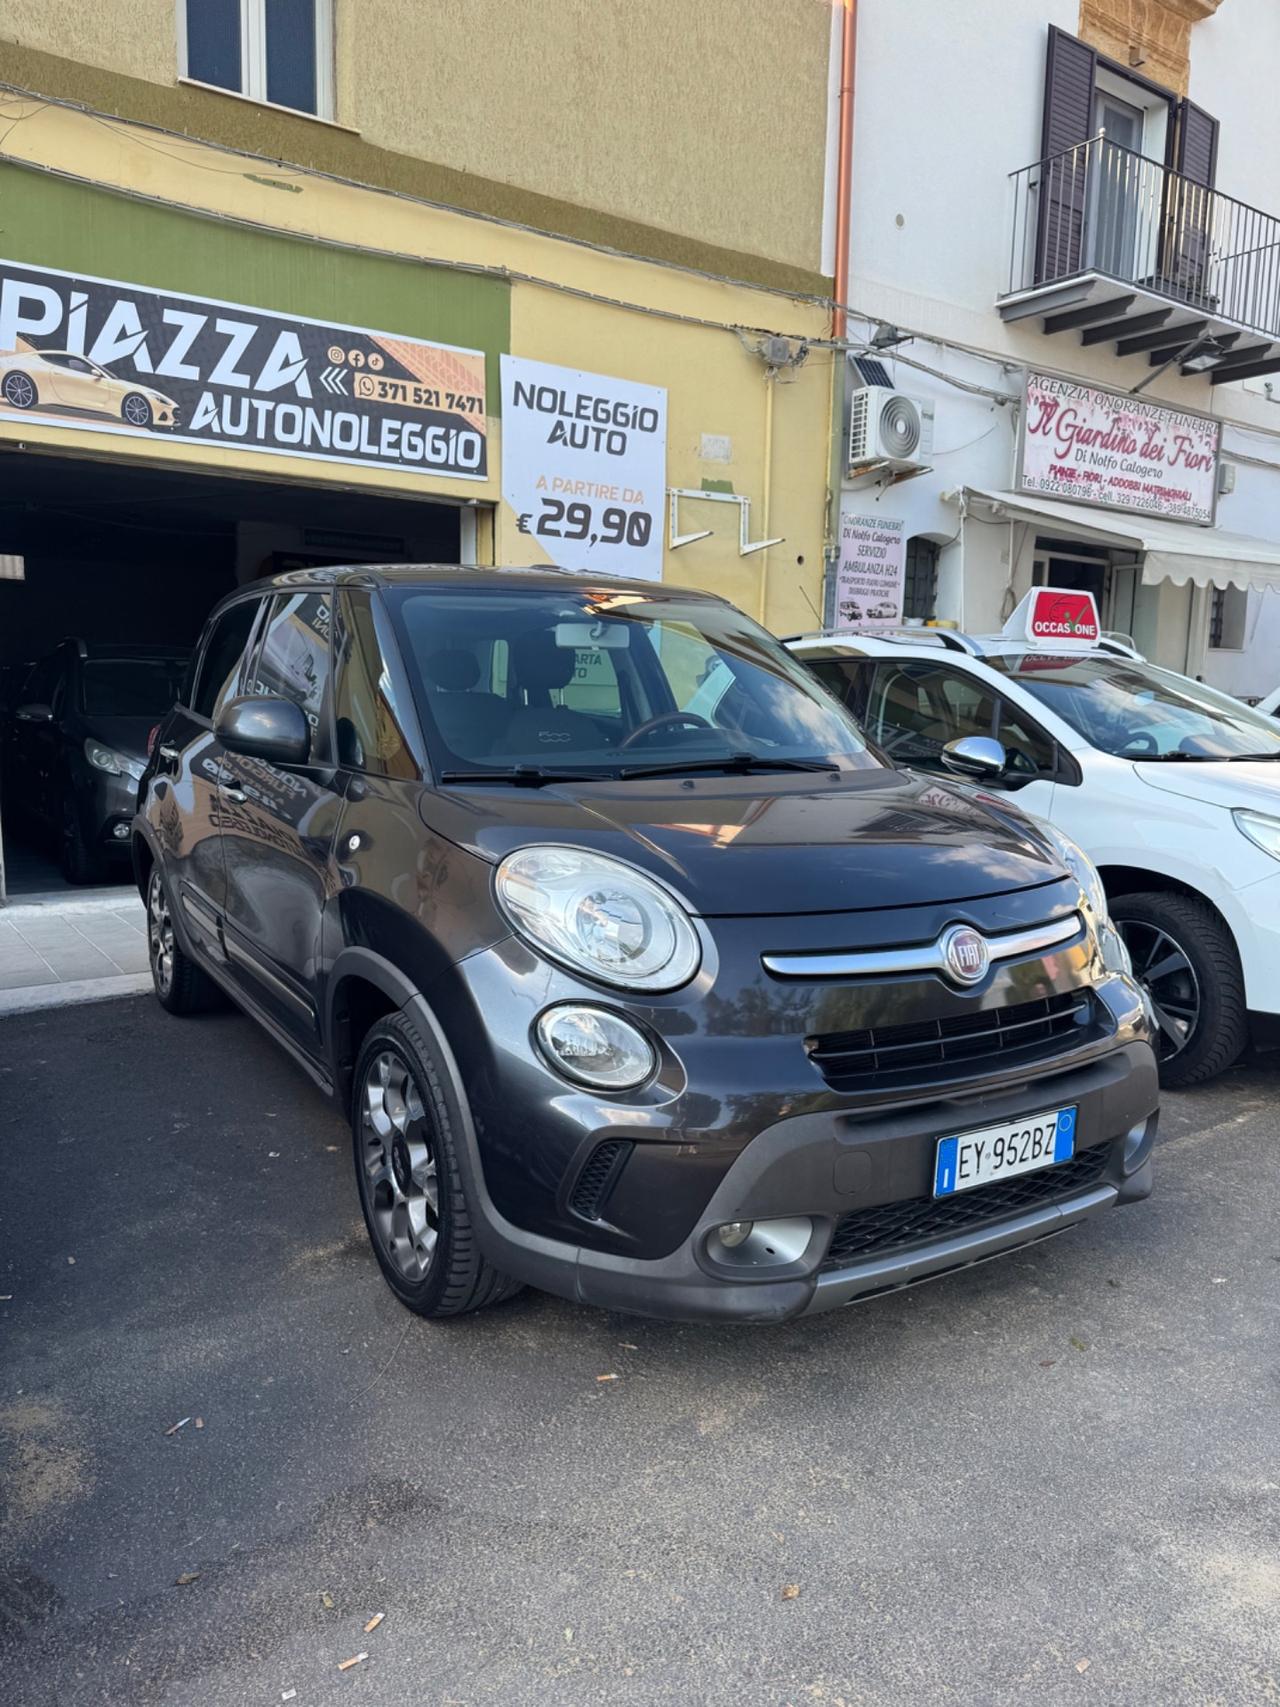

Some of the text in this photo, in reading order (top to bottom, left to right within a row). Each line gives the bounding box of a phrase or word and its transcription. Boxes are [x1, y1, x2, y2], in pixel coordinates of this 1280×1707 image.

[378, 381, 484, 415] 371 521 7471
[1028, 376, 1218, 435] AGENZIA ONORANZE FUNEBRI
[547, 420, 627, 456] AUTO
[1055, 408, 1137, 460] Giardino
[1140, 423, 1165, 462] dei
[1167, 434, 1212, 472] Fiori
[1075, 448, 1163, 479] Di Nolfo Calogero
[536, 475, 645, 505] A PARTIRE DA
[1022, 475, 1037, 489] Tel.
[1040, 478, 1060, 493] 0922
[536, 497, 652, 547] 29,90
[857, 545, 887, 559] SERVIZIO
[842, 560, 898, 577] AMBULANZA H24
[957, 944, 980, 967] FIAT
